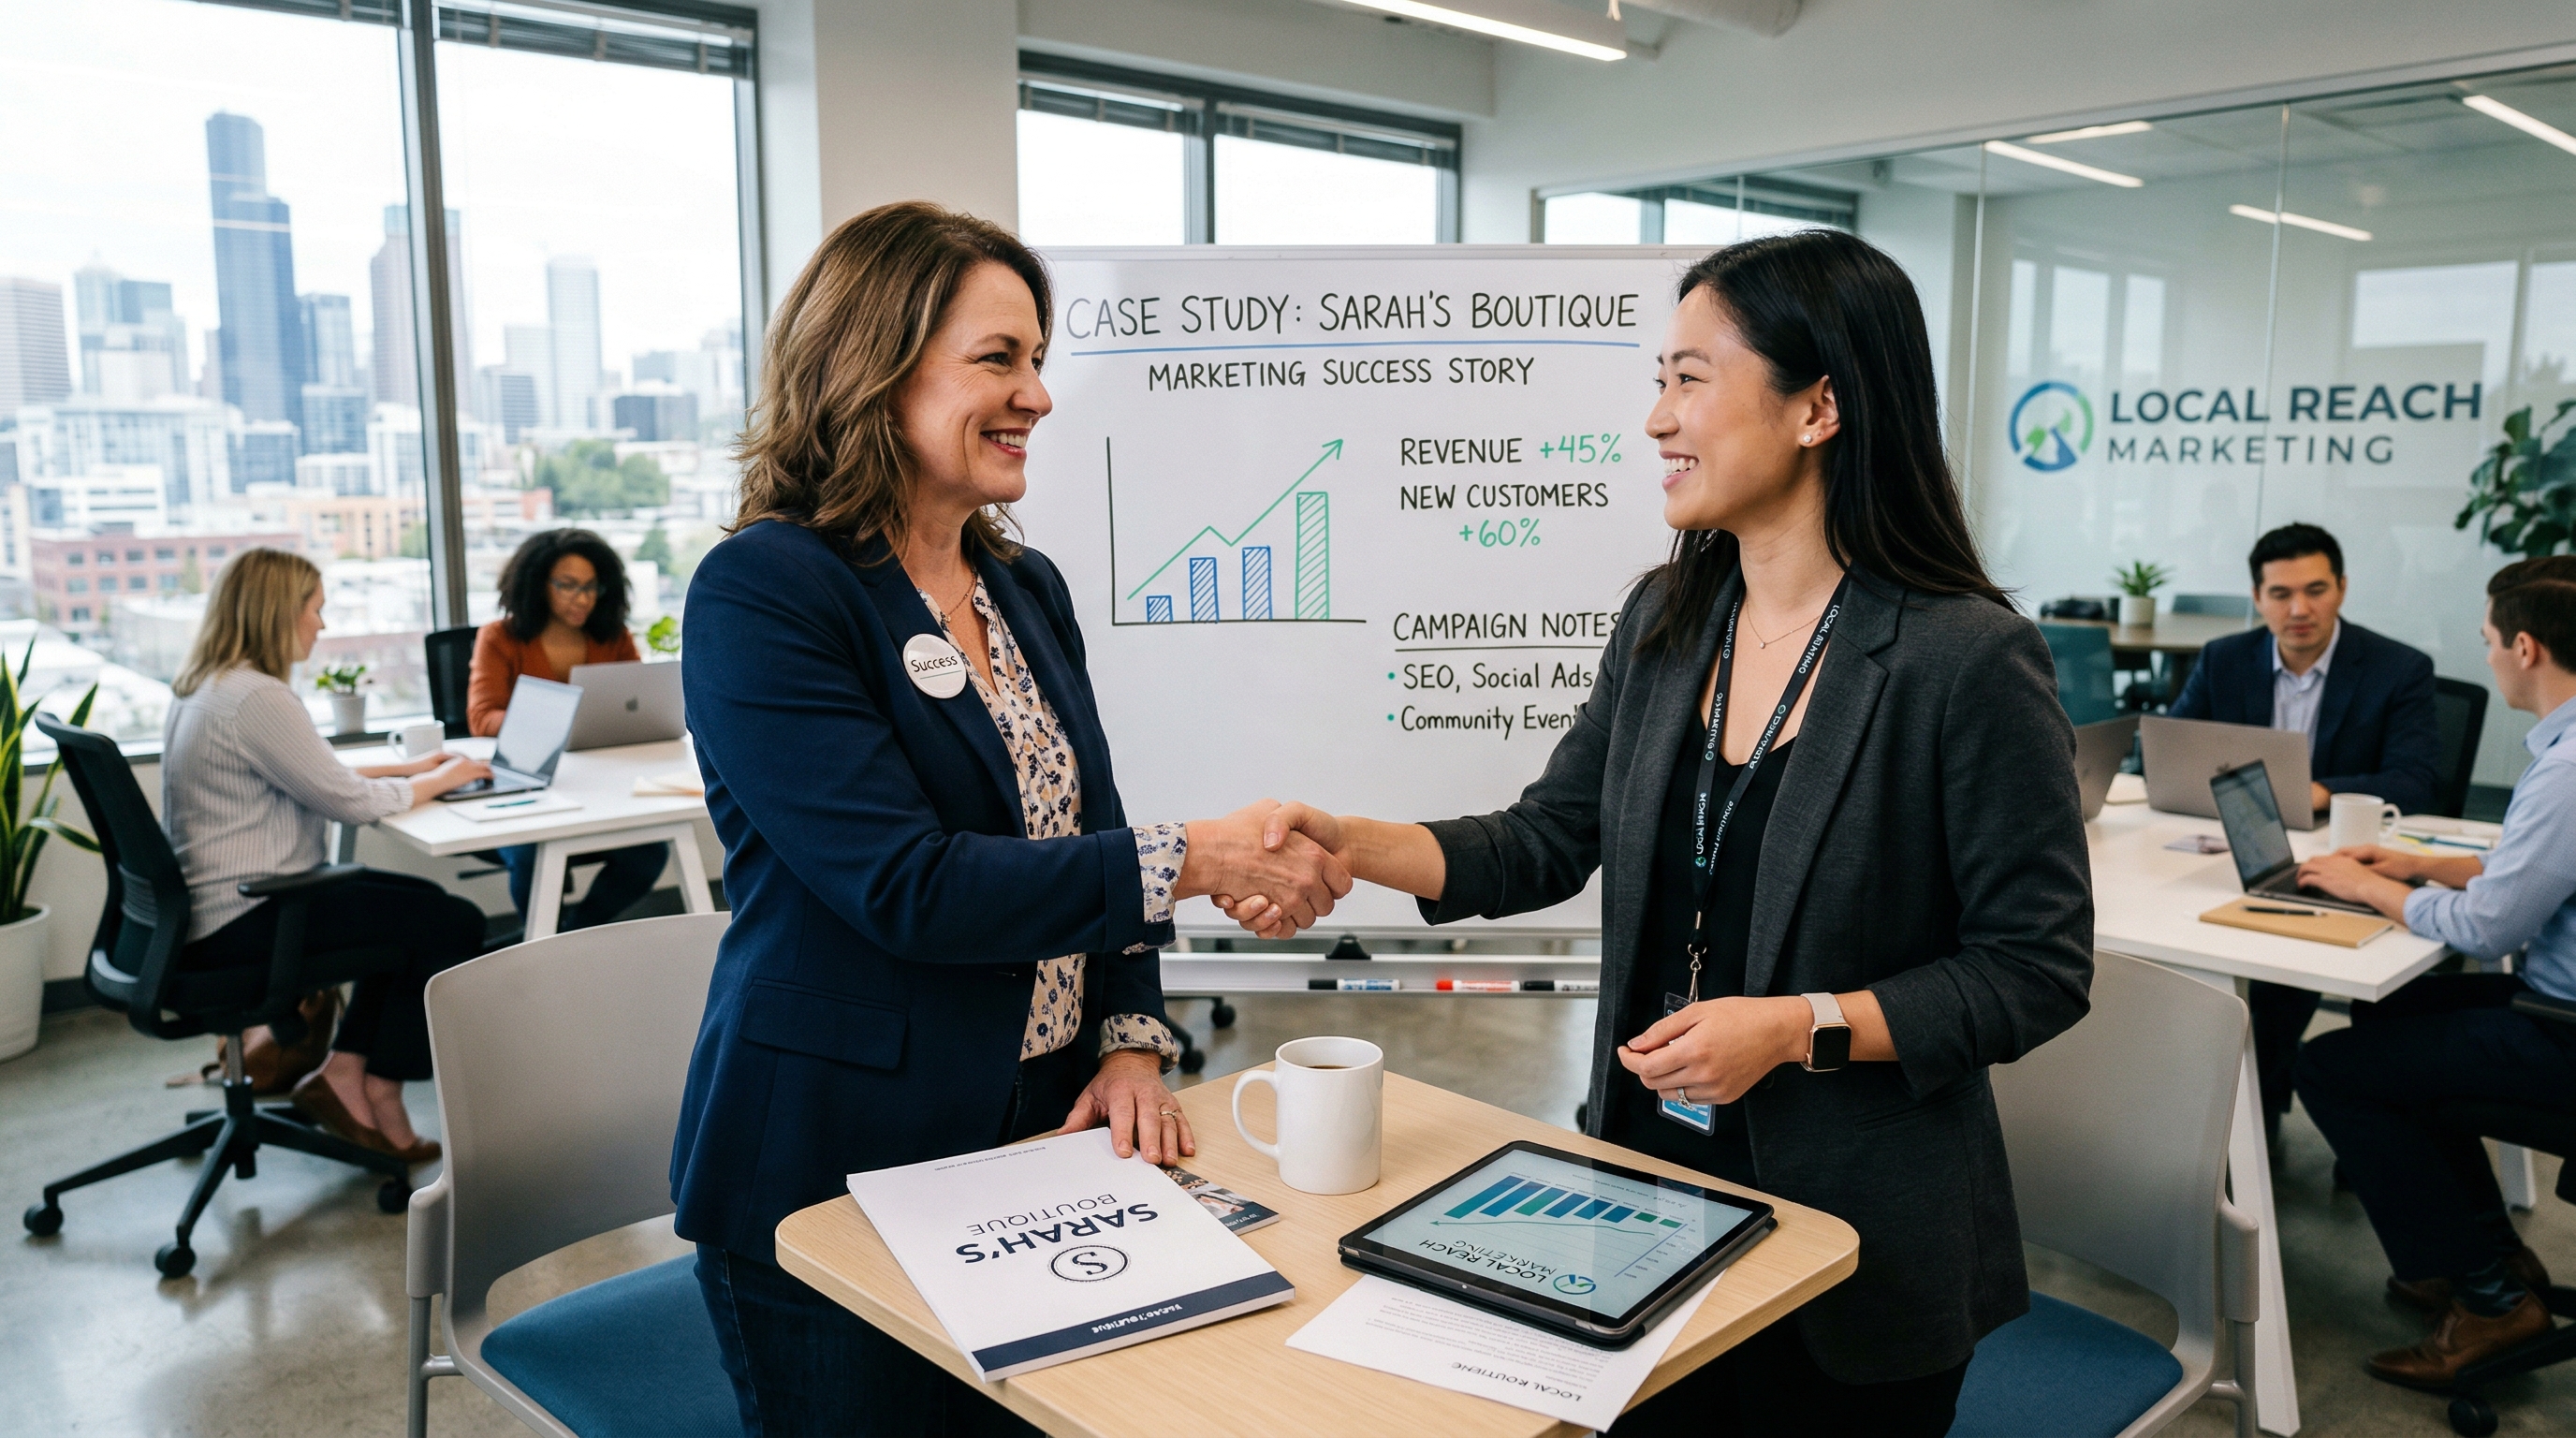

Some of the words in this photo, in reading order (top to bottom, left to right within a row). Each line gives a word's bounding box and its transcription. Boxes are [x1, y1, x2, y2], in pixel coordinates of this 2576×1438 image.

[1066, 296, 1162, 339] CASE
[1181, 294, 1301, 335] STUDY:
[1319, 289, 1451, 330] SARAH'S
[1471, 292, 1639, 329] BOUTIQUE
[1149, 360, 1307, 391] MARKETING
[1323, 358, 1432, 386] SUCCESS
[1448, 357, 1535, 386] STORY
[2111, 389, 2271, 424] LOCAL
[2290, 383, 2481, 421] REACH
[1400, 437, 1523, 466] REVENUE
[1539, 433, 1622, 463] +45%
[2108, 435, 2393, 464] MARKETING
[1400, 484, 1456, 510] NEW
[1466, 482, 1609, 508] CUSTOMERS
[1458, 517, 1541, 548] +60%
[1393, 612, 1527, 641] CAMPAIGN
[911, 655, 958, 673] Success
[1403, 663, 1460, 694] SEO,
[1472, 662, 1540, 689] Social
[1551, 662, 1593, 689] Ads
[1400, 705, 1515, 741] Community
[966, 1194, 1118, 1236] BOUTIQUE
[956, 1203, 1158, 1263] SARAH'S
[1418, 1239, 1482, 1264] REACH
[1452, 1240, 1558, 1275] MARKETING
[1486, 1257, 1547, 1284] LOCAL
